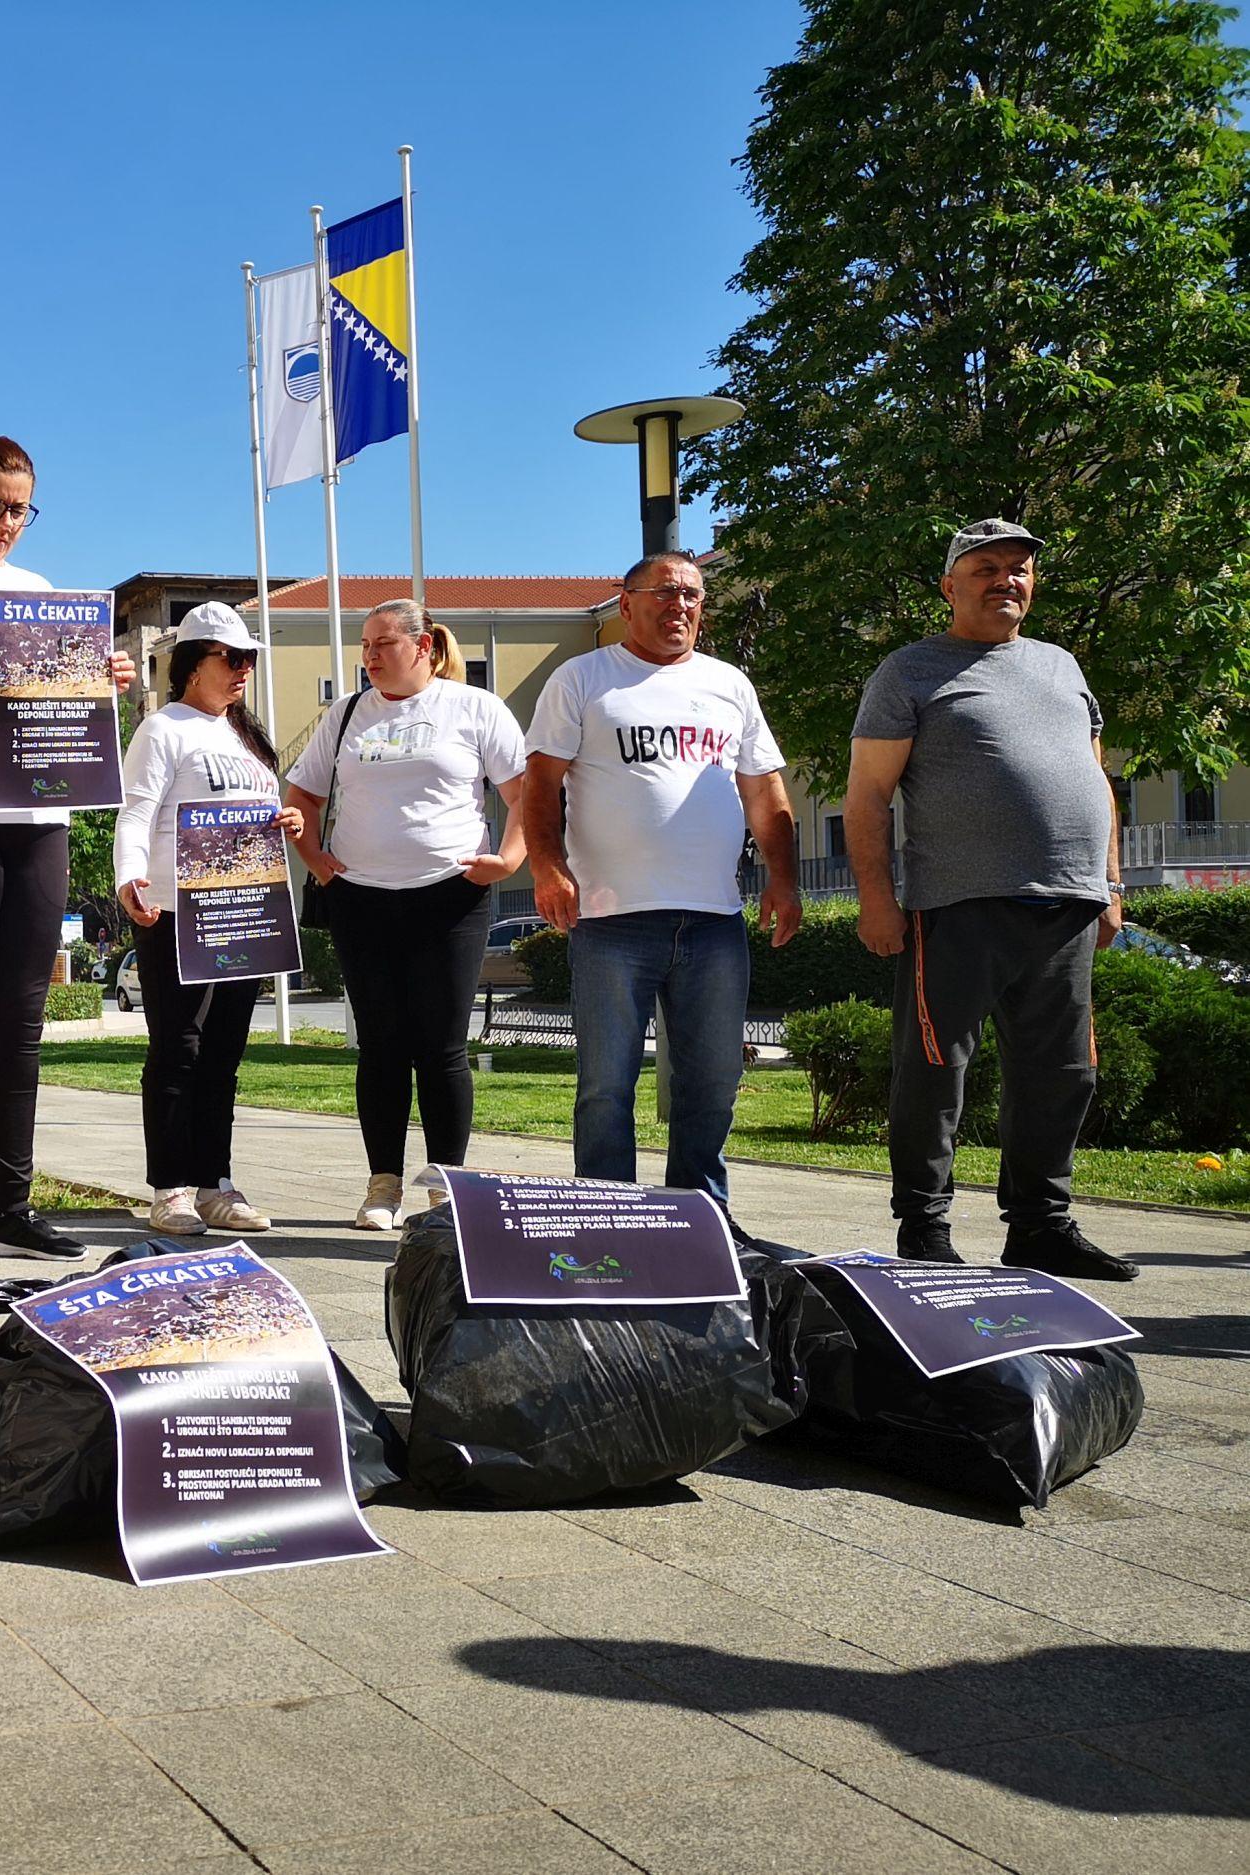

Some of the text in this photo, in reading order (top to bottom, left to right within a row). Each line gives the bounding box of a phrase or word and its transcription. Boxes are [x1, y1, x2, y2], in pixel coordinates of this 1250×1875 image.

[4, 600, 99, 621] ŠTA ČEKATE?
[8, 701, 95, 710] KAKO RIJEŠITI PROBLEM
[18, 711, 54, 719] DEPONIJE
[616, 726, 732, 765] UBORAK
[190, 808, 272, 825] ŠTA ČEKATE?
[191, 891, 209, 899] KAKO
[237, 887, 270, 895] PROBLEM
[504, 1219, 519, 1230] 3.
[57, 1262, 237, 1316] ŠTA ČEKATE?
[138, 1372, 179, 1385] KAKO
[238, 1370, 299, 1384] PROBLEM
[232, 1386, 291, 1399] UBORAK?
[162, 1418, 175, 1433] 1.
[176, 1417, 215, 1425] ZATVORITI
[221, 1417, 255, 1425] SANIRATI
[257, 1417, 291, 1425] DEPONIJU
[177, 1427, 208, 1435] UBORAK
[210, 1427, 215, 1435] U
[217, 1425, 231, 1435] ŠTO
[233, 1425, 262, 1435] KRAĆEM
[162, 1442, 175, 1458] 2.
[177, 1447, 203, 1457] IZNAĆI
[205, 1448, 227, 1456] NOVU
[229, 1448, 263, 1456] LOKACIJU
[265, 1448, 275, 1456] ZA
[163, 1472, 176, 1488] 3.
[178, 1470, 213, 1478] OBRISATI
[215, 1468, 256, 1478] POSTOJEĆU
[258, 1469, 293, 1477] DEPONIJU
[178, 1478, 321, 1489] PROSTORNOG PLANA GRADA MOSTARA
[184, 1491, 224, 1500] KANTONA!
